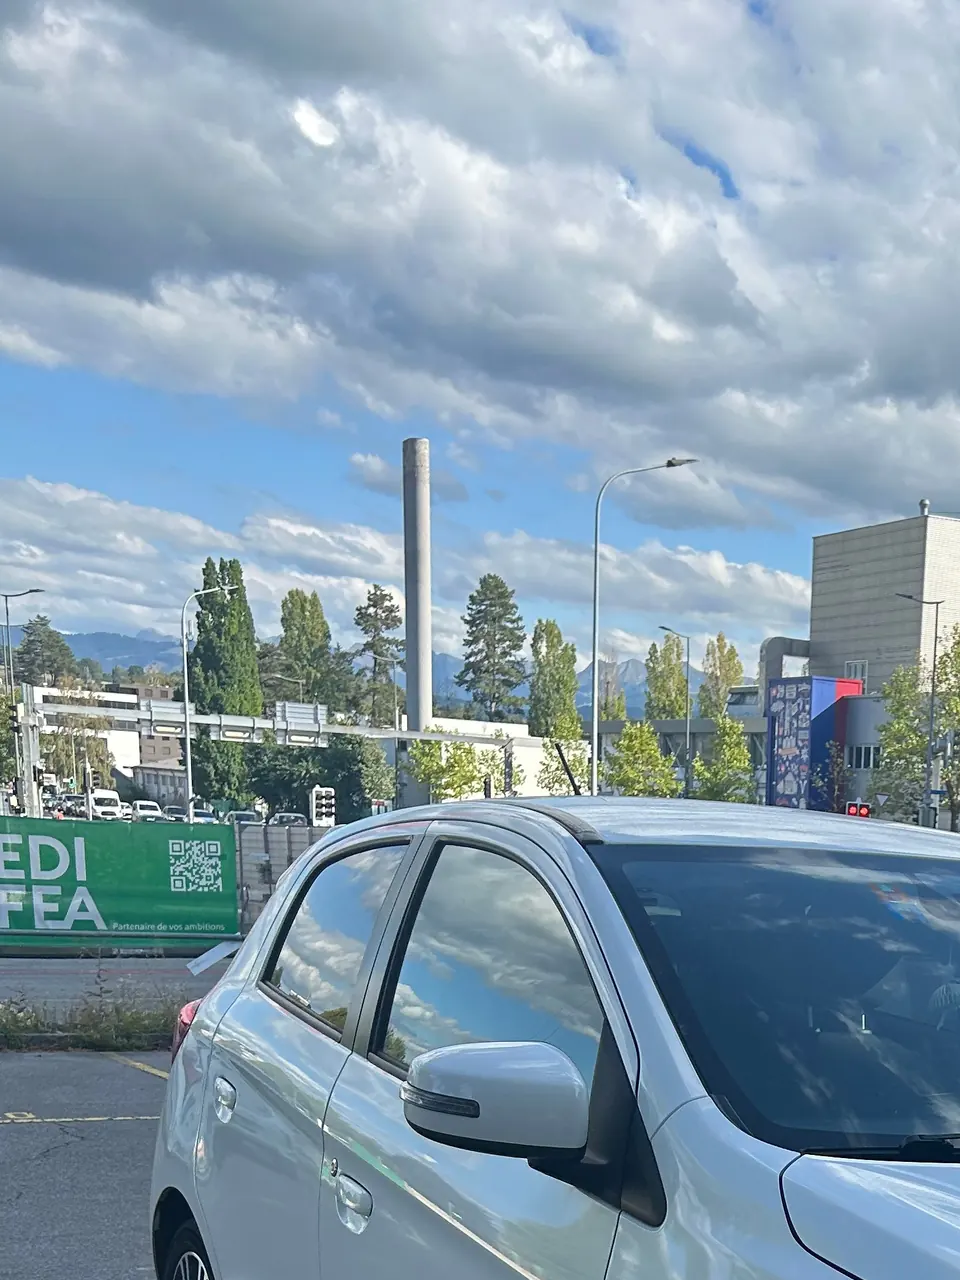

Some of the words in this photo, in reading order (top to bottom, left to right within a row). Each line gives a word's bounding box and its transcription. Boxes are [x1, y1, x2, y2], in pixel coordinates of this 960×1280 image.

[0, 884, 108, 930] FEA
[112, 922, 155, 931] Partenaire
[157, 922, 167, 931] de
[184, 923, 225, 931] ambitions
